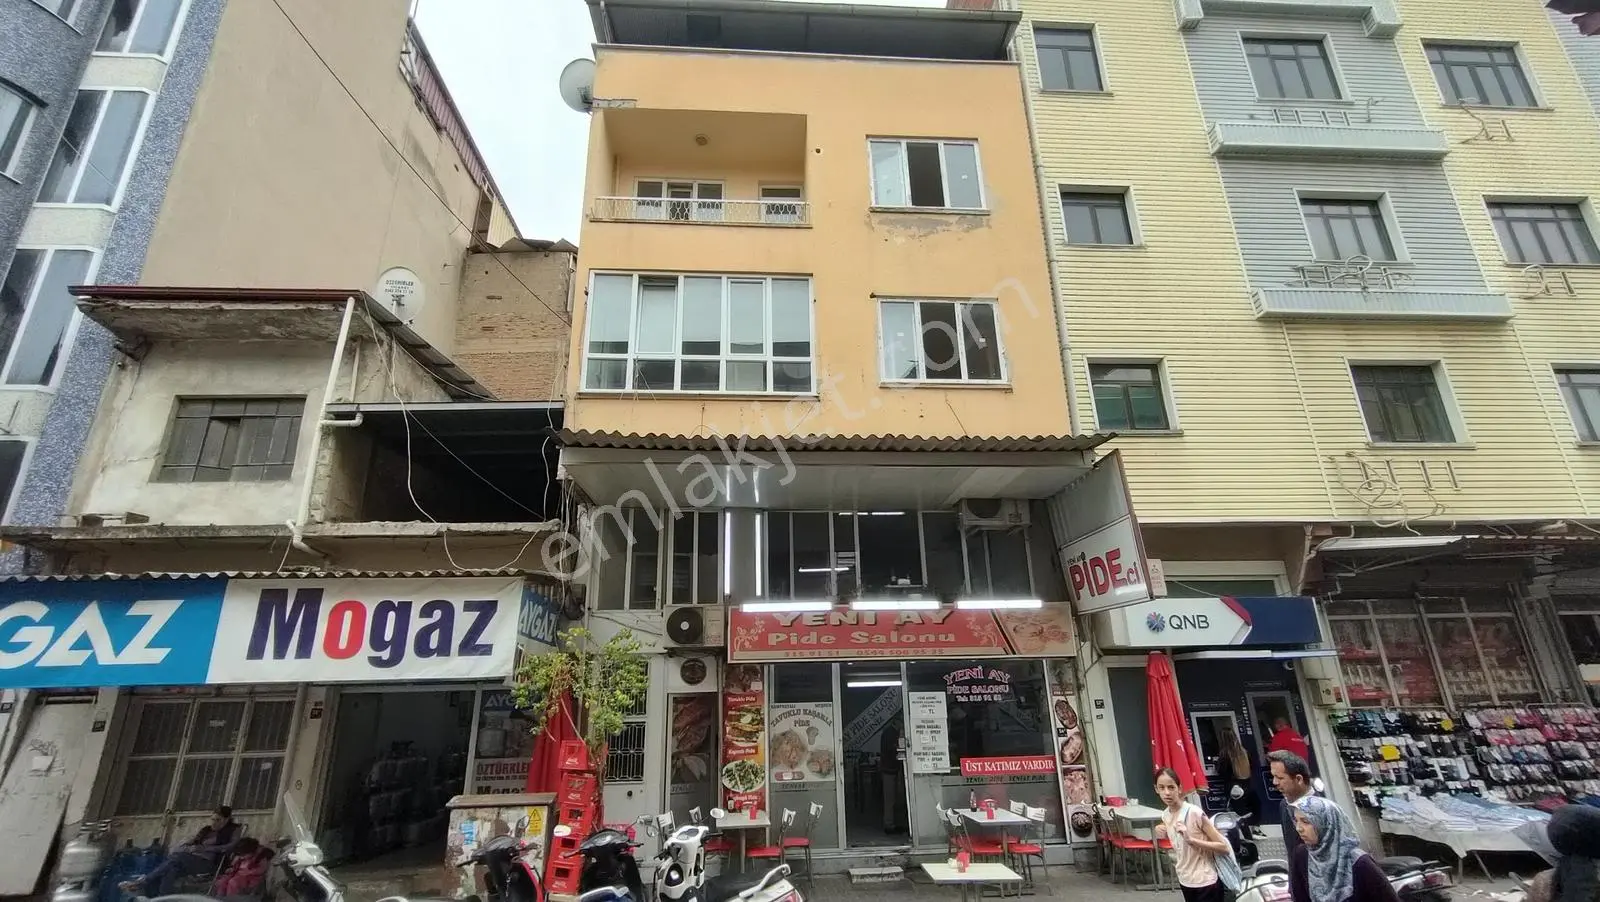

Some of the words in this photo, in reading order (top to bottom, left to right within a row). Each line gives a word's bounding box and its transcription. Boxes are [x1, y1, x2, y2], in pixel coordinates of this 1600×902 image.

[519, 599, 557, 643] AYGAZ
[893, 609, 955, 626] AY
[1169, 614, 1210, 630] QNB
[0, 600, 185, 669] GAZ
[246, 588, 498, 668] Mogaz
[767, 631, 837, 646] Pide
[850, 630, 956, 644] Salonu
[943, 665, 984, 685] YENİ
[988, 669, 1011, 684] AY
[971, 684, 1009, 694] SALONU
[965, 761, 982, 772] ÜST
[984, 761, 1021, 772] KATIMIZ
[1022, 760, 1055, 770] VARDIR
